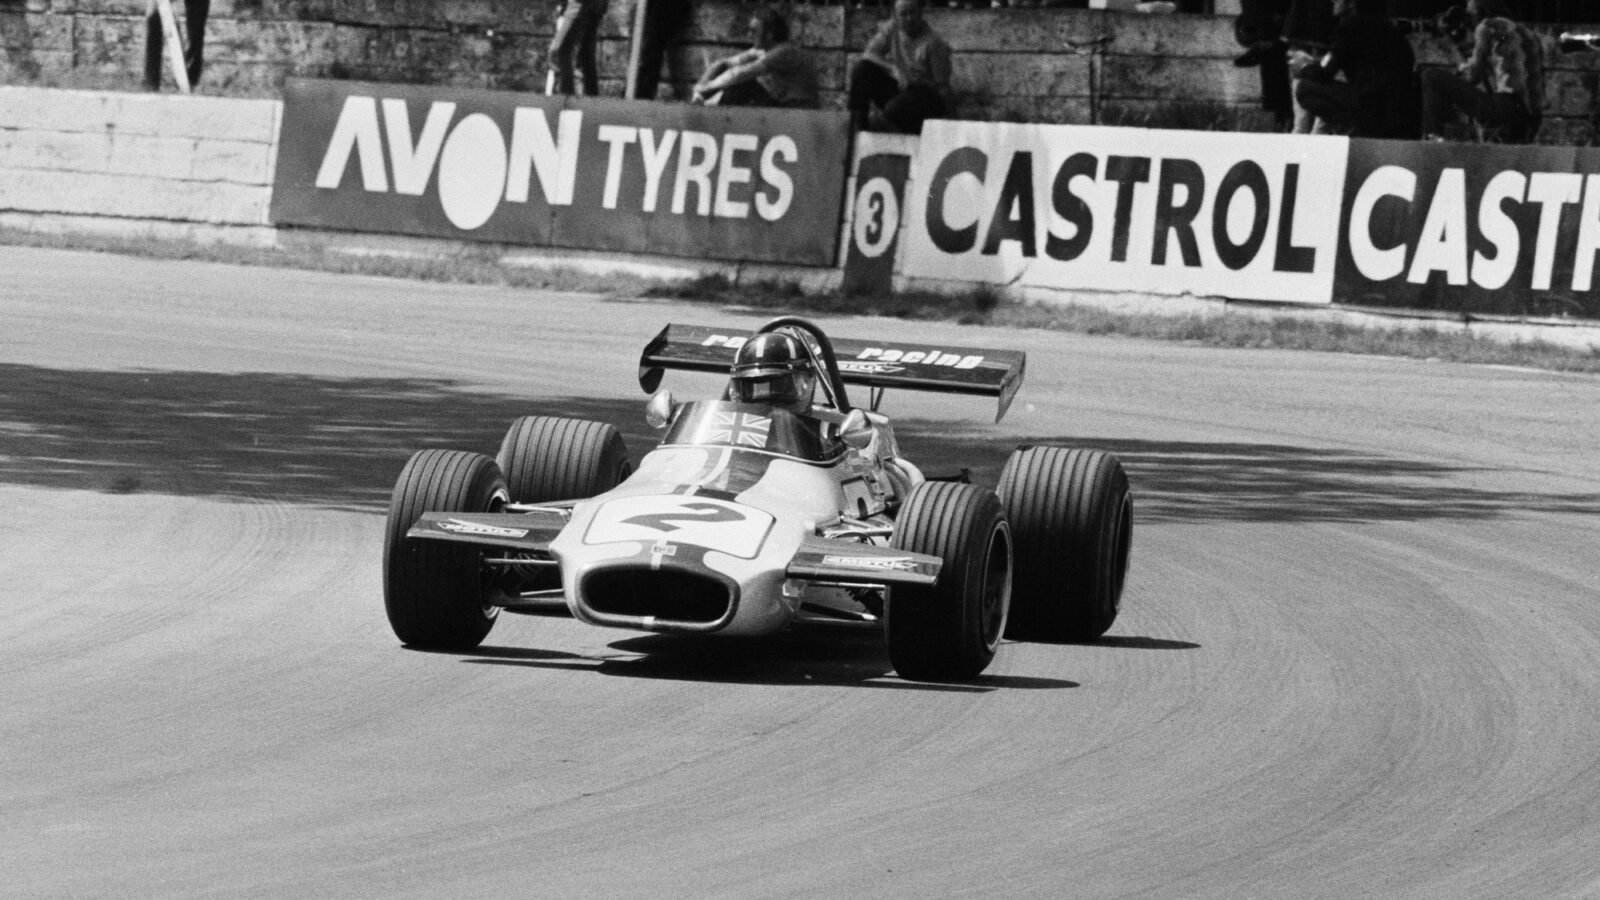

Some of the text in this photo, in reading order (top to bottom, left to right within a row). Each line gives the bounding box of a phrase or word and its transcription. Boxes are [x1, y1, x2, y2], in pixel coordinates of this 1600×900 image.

[315, 95, 798, 230] AVON TYRES
[865, 191, 885, 247] 3
[925, 146, 1316, 273] CASTROL
[856, 347, 985, 370] racing
[619, 502, 747, 532] 2
